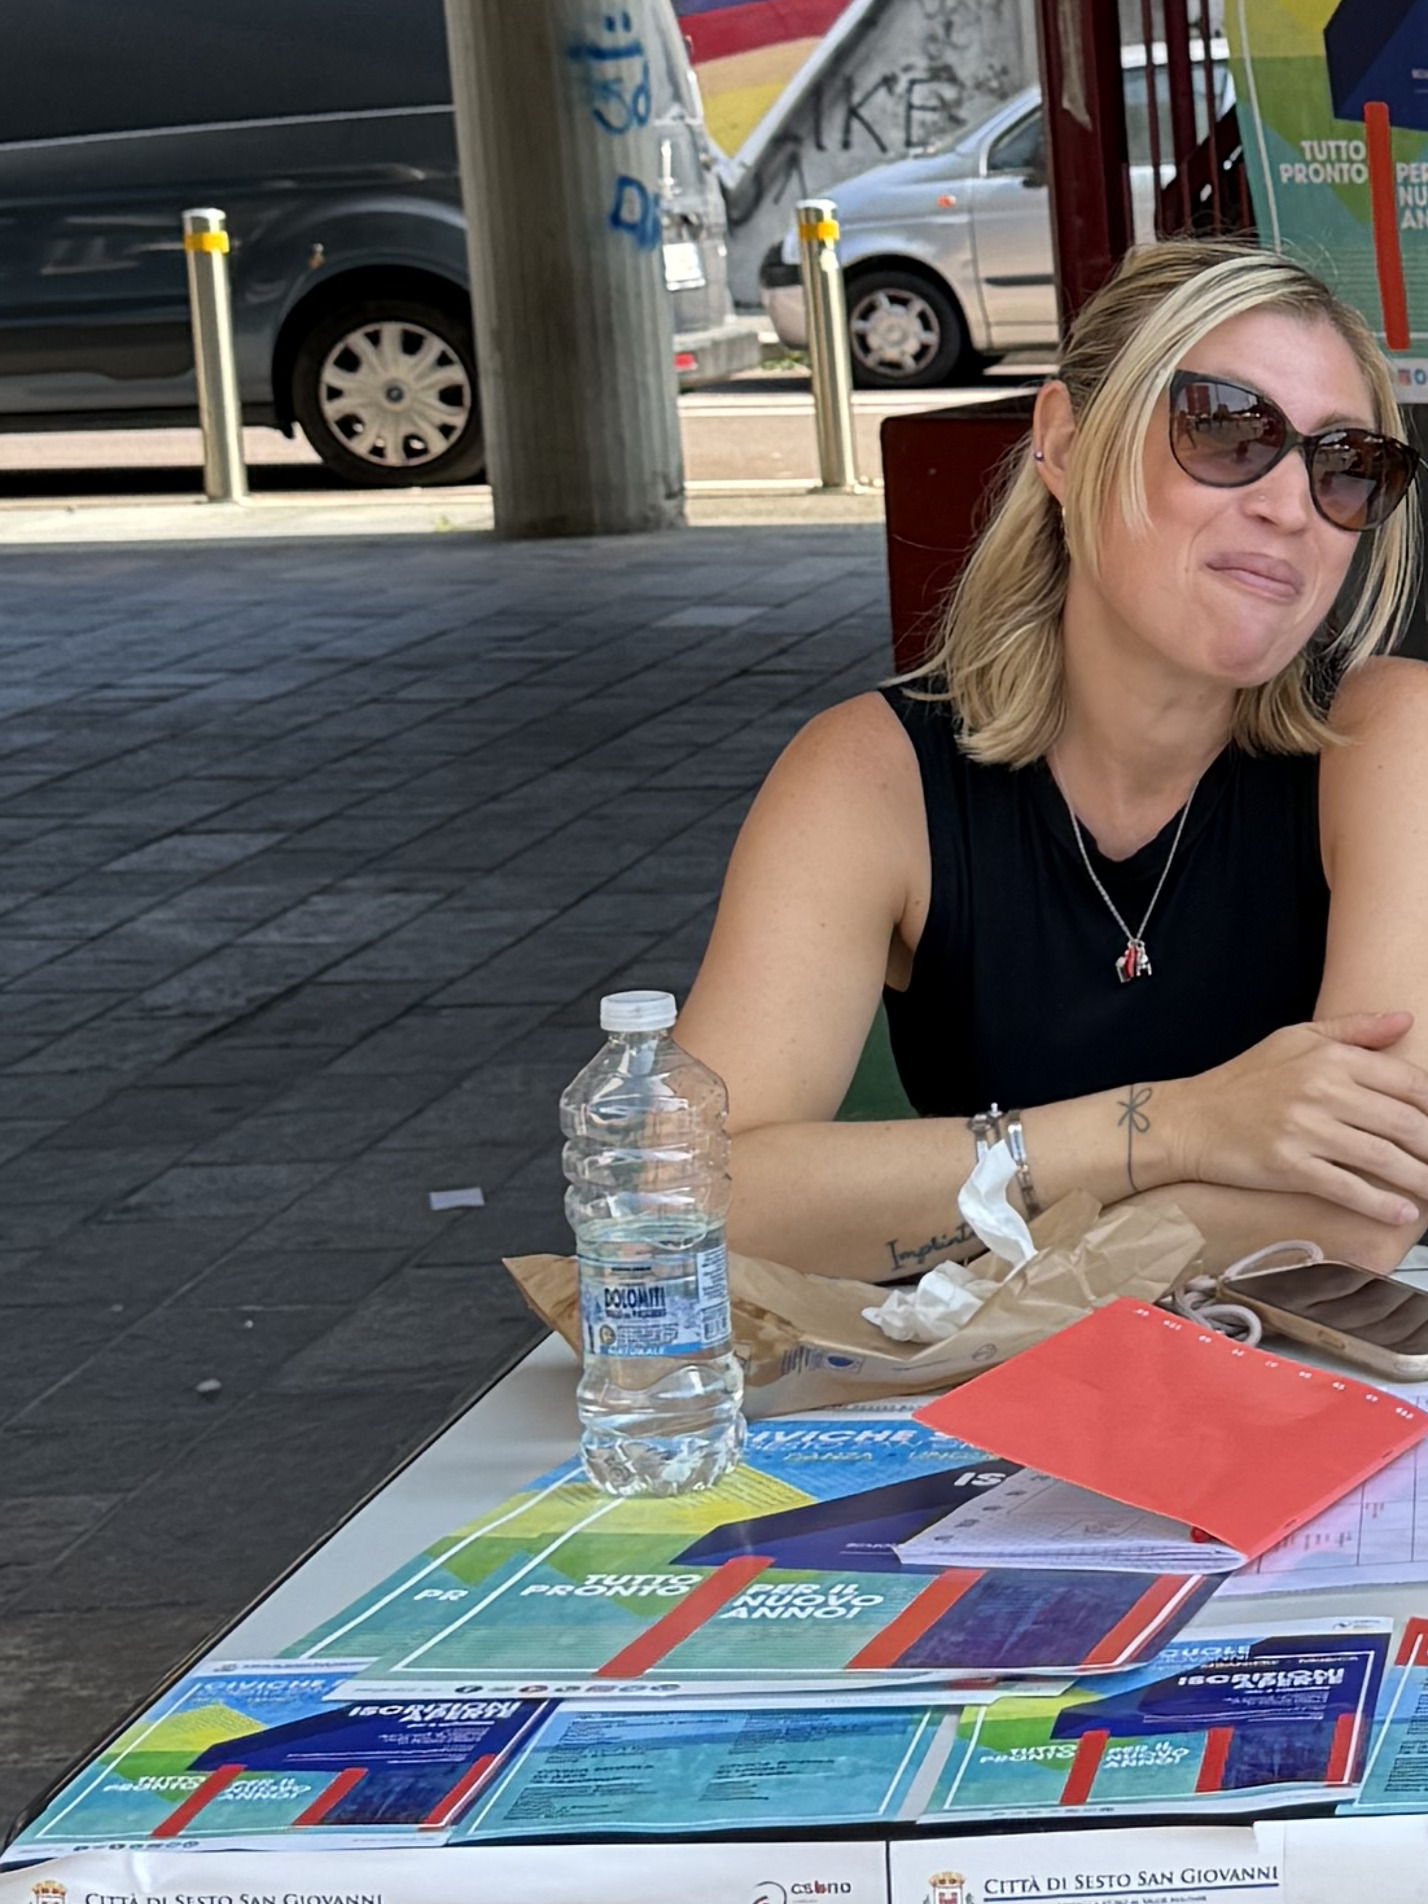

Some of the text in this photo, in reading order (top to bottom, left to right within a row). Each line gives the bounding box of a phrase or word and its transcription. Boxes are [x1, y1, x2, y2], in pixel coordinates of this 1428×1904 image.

[1301, 140, 1367, 161] TUTTO
[1280, 163, 1368, 184] PRONTO
[604, 1286, 666, 1309] DOLOMITI
[584, 1574, 703, 1585] TUTTO
[520, 1584, 690, 1596] PRONTO
[746, 1583, 859, 1595] PER IL
[731, 1594, 884, 1607] NUOVO
